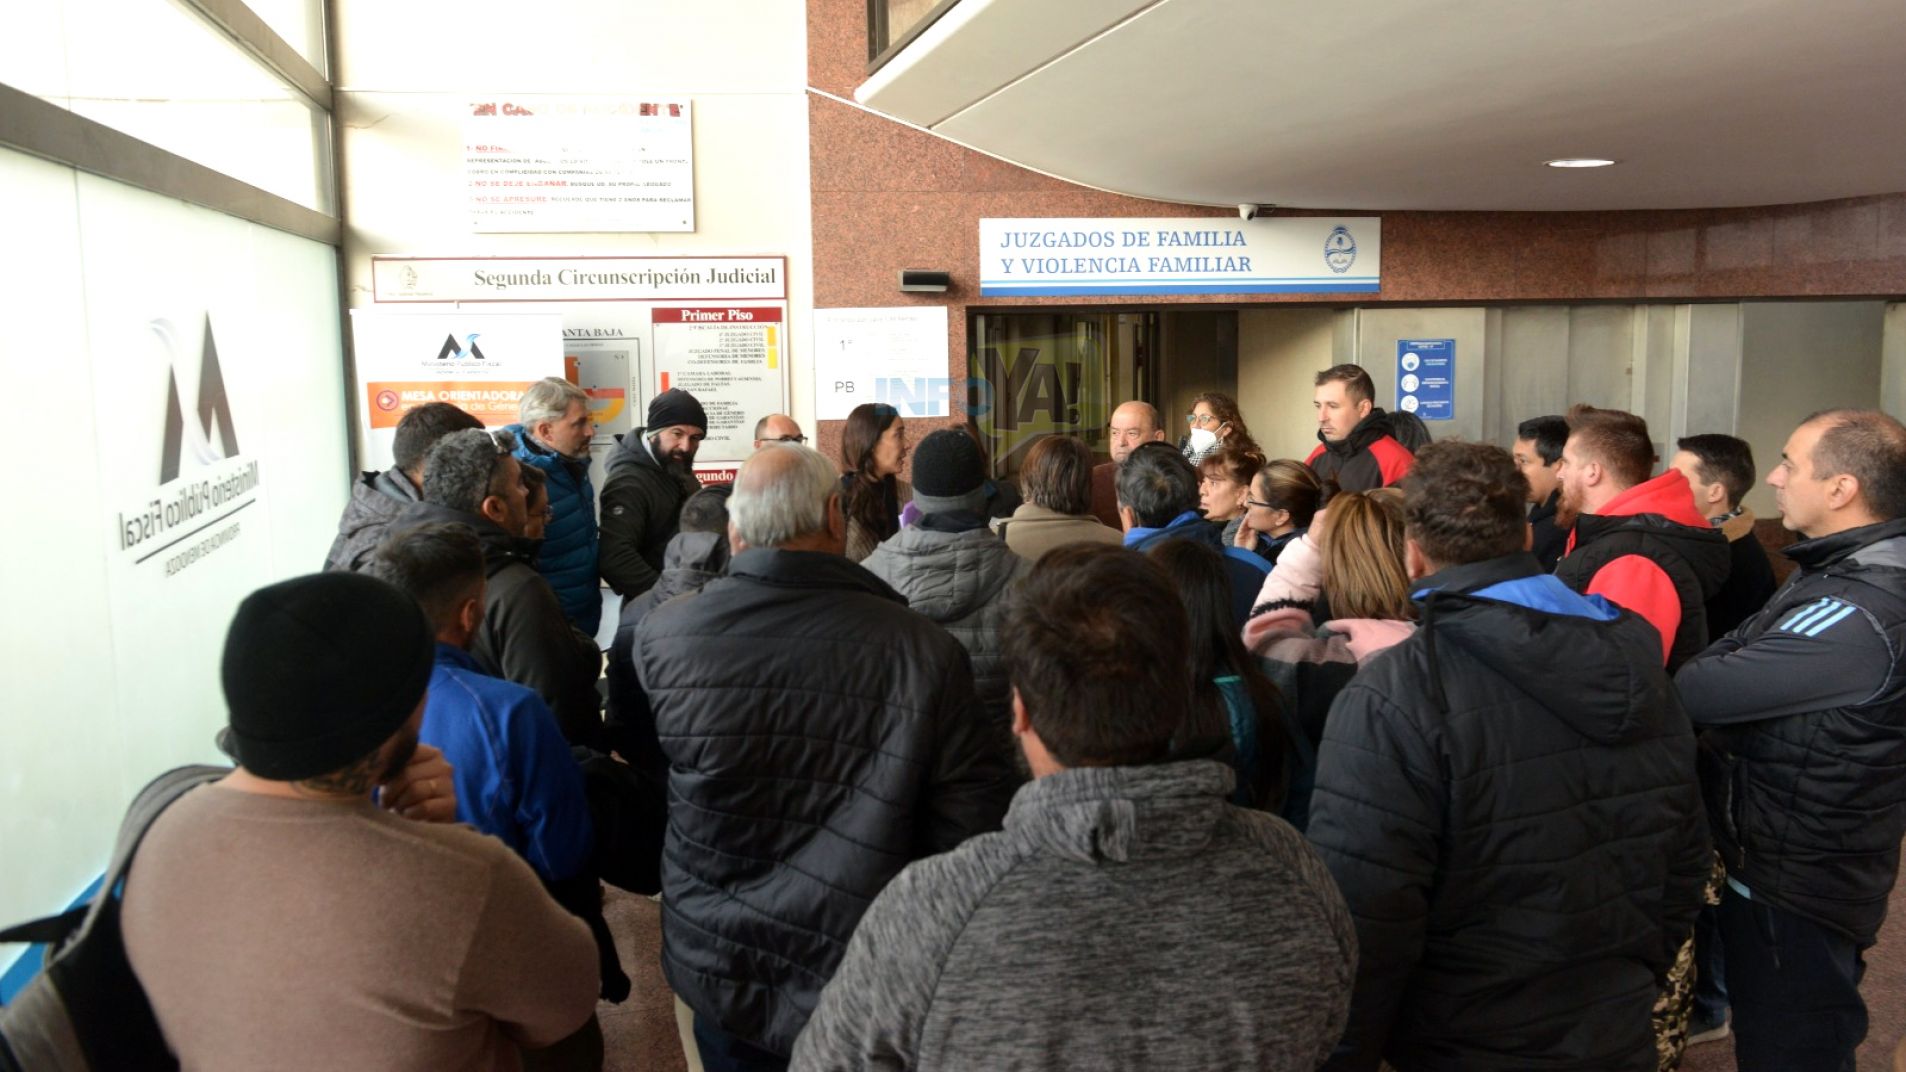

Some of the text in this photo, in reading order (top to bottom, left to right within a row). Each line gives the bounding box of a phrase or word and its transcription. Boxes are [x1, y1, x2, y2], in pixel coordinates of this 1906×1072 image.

[1000, 230, 1247, 248] JUZGADOS DE FAMILIA
[1001, 256, 1252, 274] Y VIOLENCIA FAMILIAR
[474, 267, 776, 290] Segunda Circunscripción Judicial
[681, 308, 754, 321] Primer Piso
[593, 328, 624, 337] BAJA
[835, 381, 855, 393] PB
[401, 391, 436, 401] MESA
[696, 470, 734, 483] gundo
